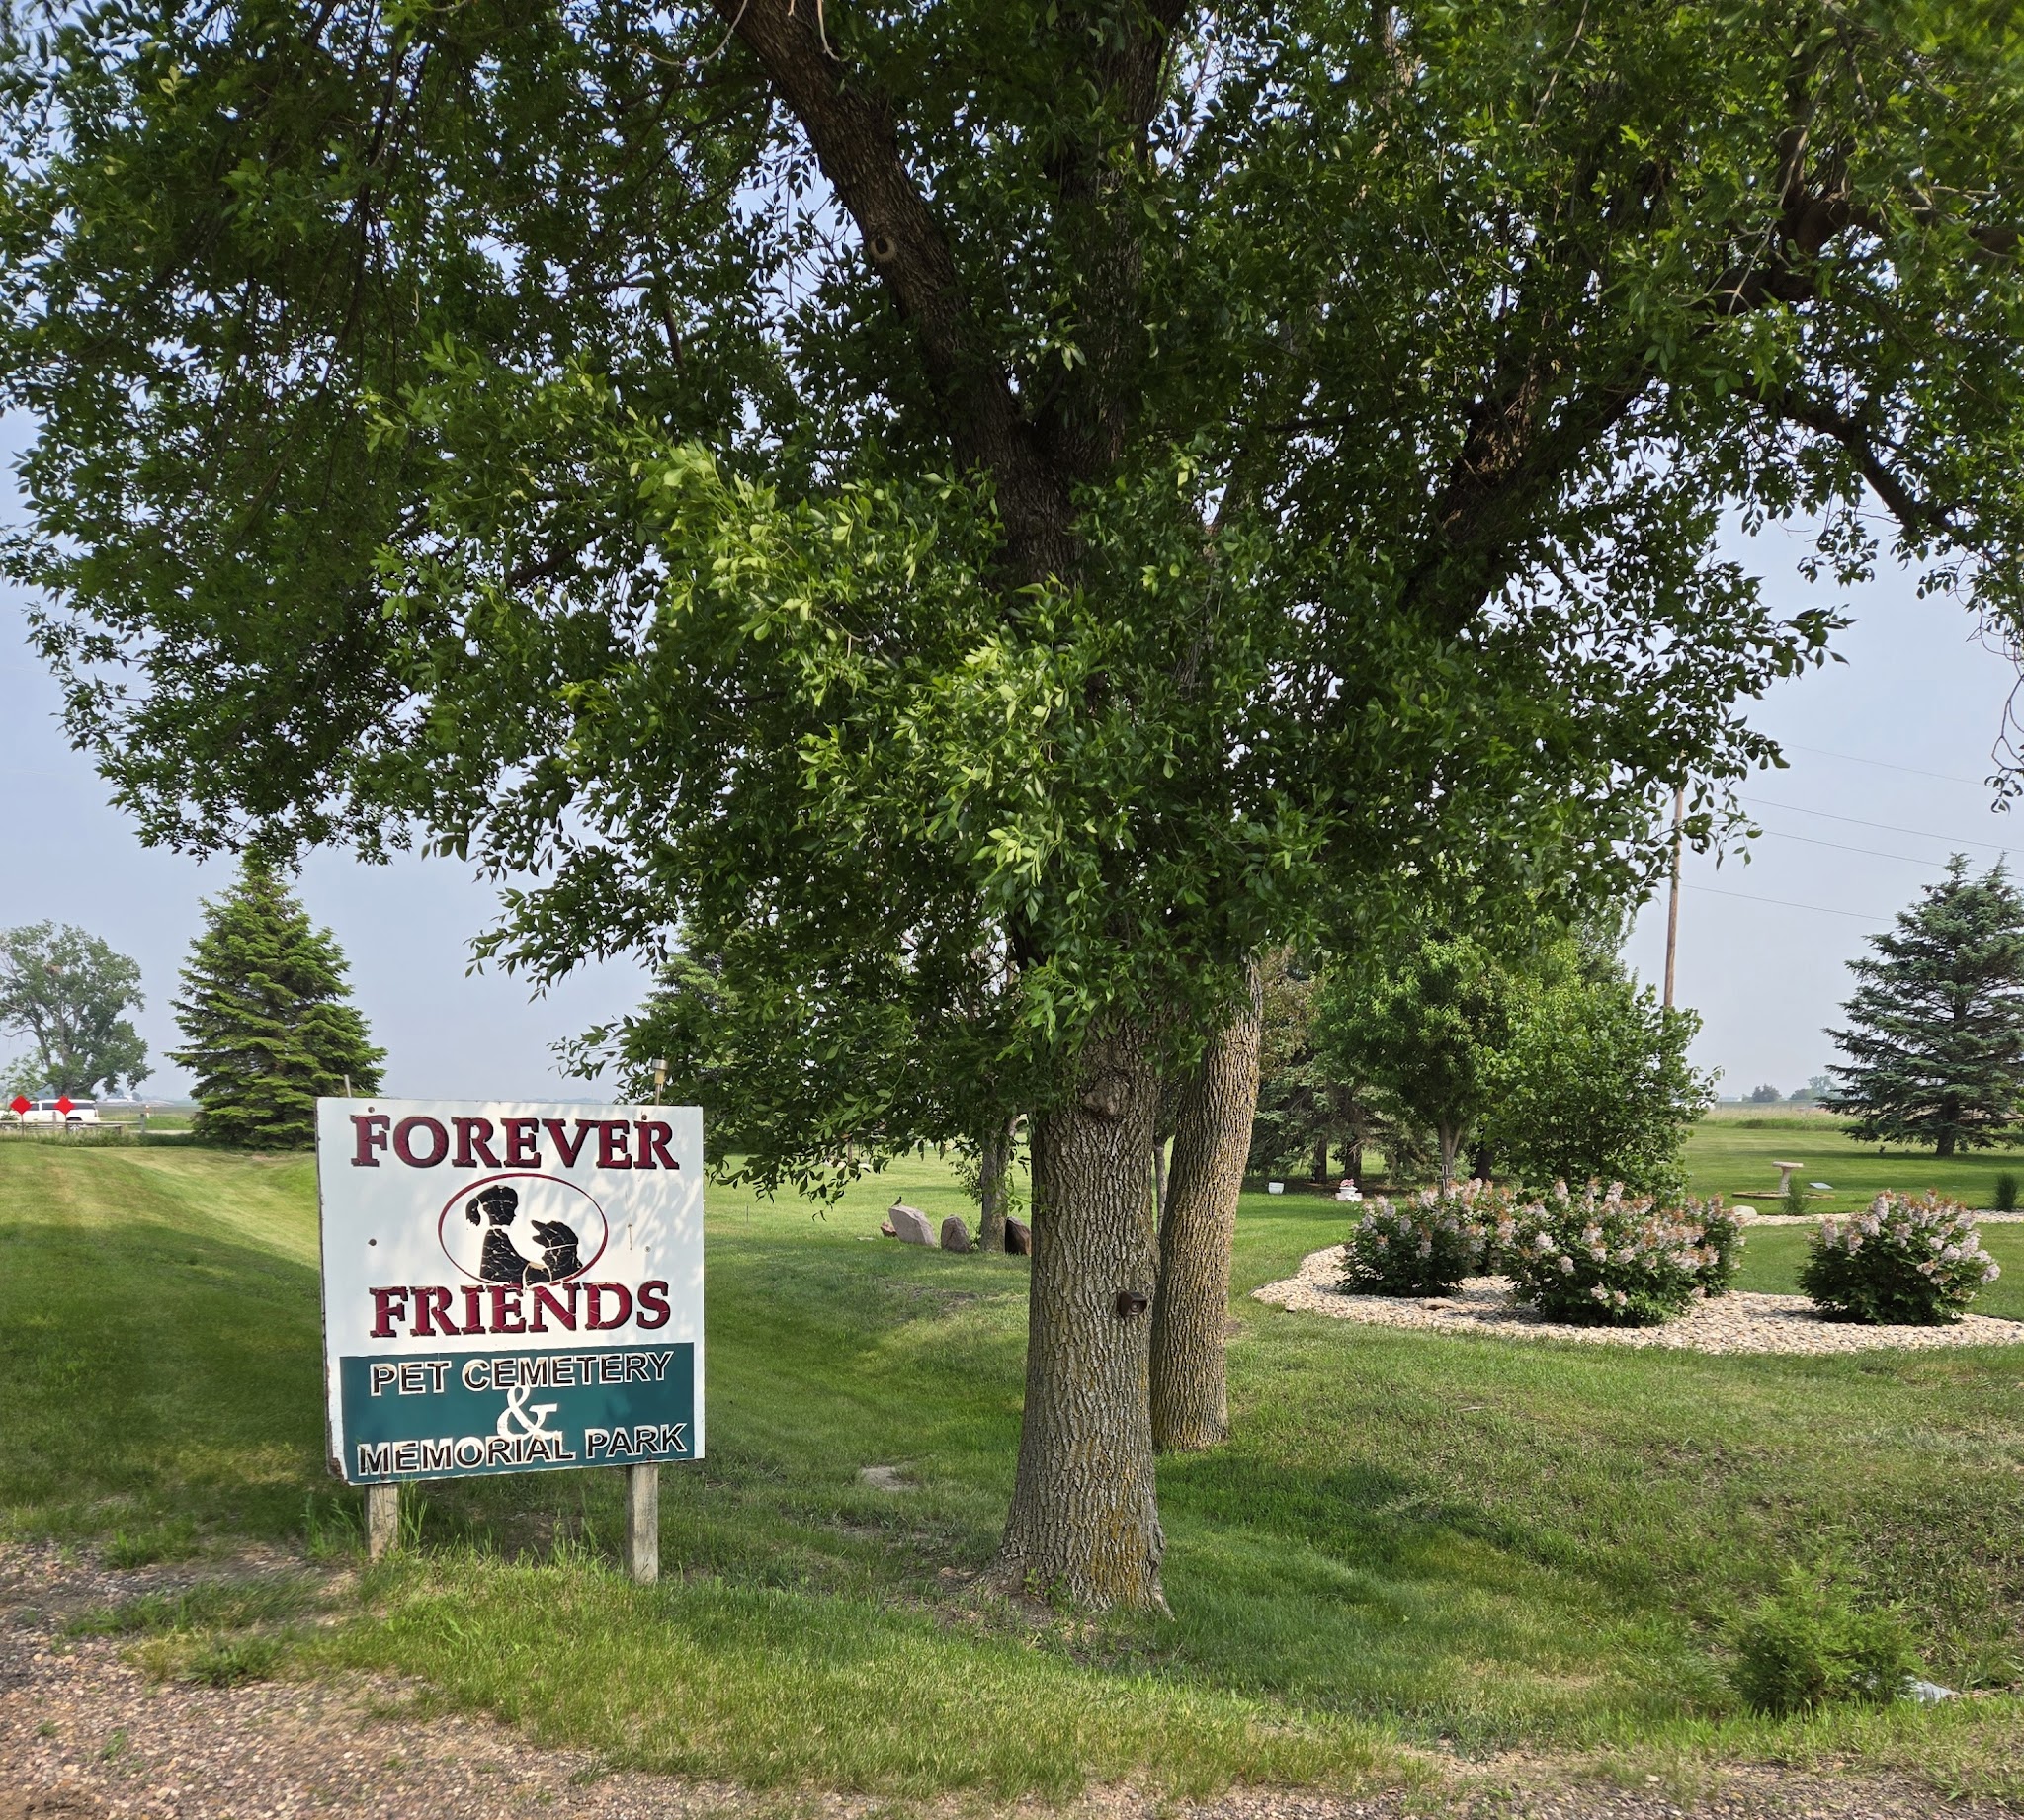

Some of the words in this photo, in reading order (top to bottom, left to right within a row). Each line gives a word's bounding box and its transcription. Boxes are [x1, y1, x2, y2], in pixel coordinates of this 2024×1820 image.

[350, 1114, 680, 1170] FOREVER
[369, 1280, 671, 1339] FRIENDS
[370, 1361, 450, 1396] PET
[461, 1351, 674, 1391] CEMETERY
[496, 1385, 560, 1440] &
[358, 1432, 577, 1475] MEMORIAL
[585, 1423, 688, 1458] PARK
